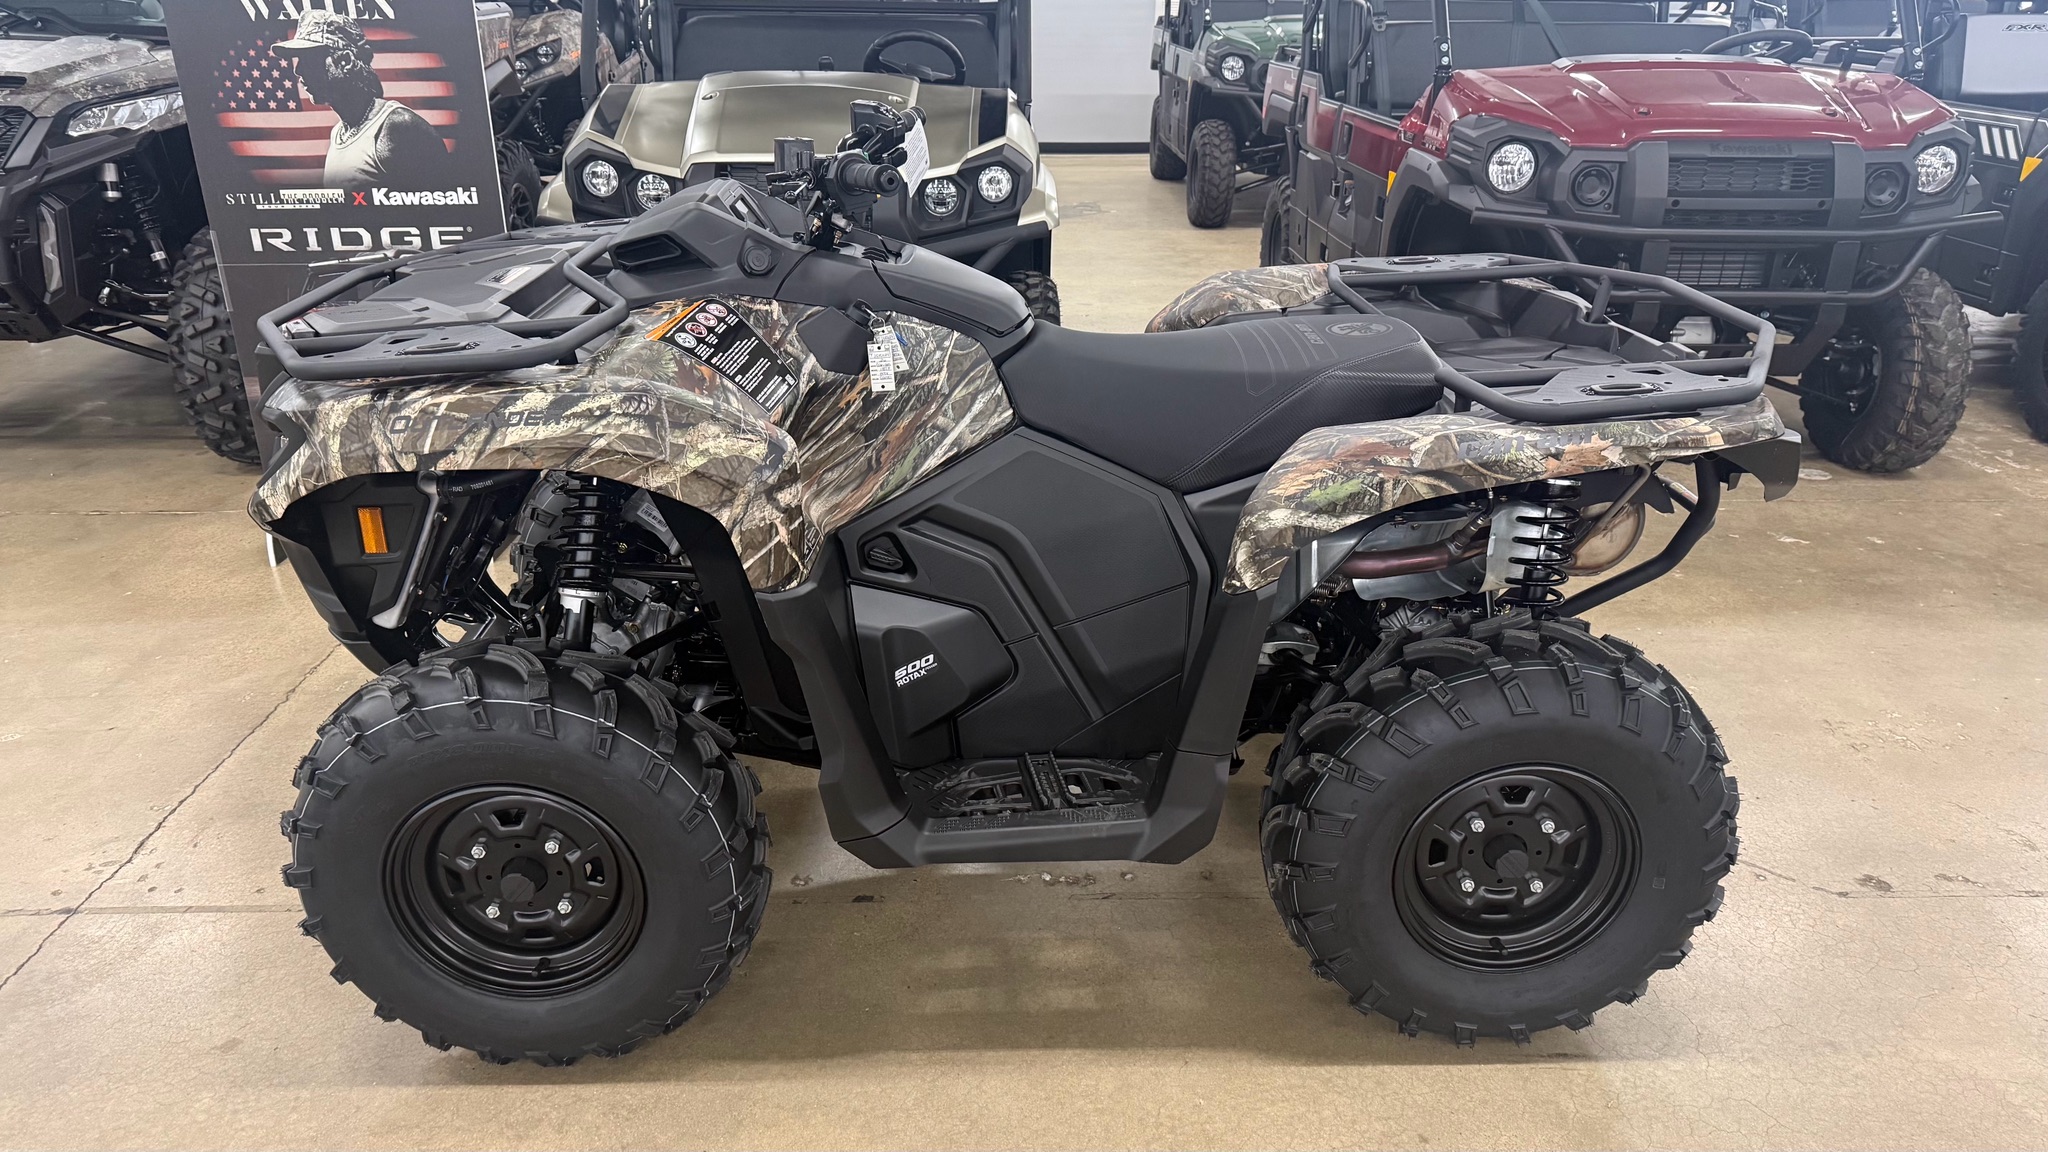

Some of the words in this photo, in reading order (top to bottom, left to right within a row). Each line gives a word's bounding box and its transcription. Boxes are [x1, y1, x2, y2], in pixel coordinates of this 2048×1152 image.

[226, 193, 280, 205] STILL
[282, 193, 300, 204] THE
[302, 192, 345, 204] PROBLEM
[371, 186, 479, 205] Kawasaki
[249, 226, 464, 252] RIDGE
[895, 653, 934, 681] 500
[896, 668, 928, 688] ROTAX
